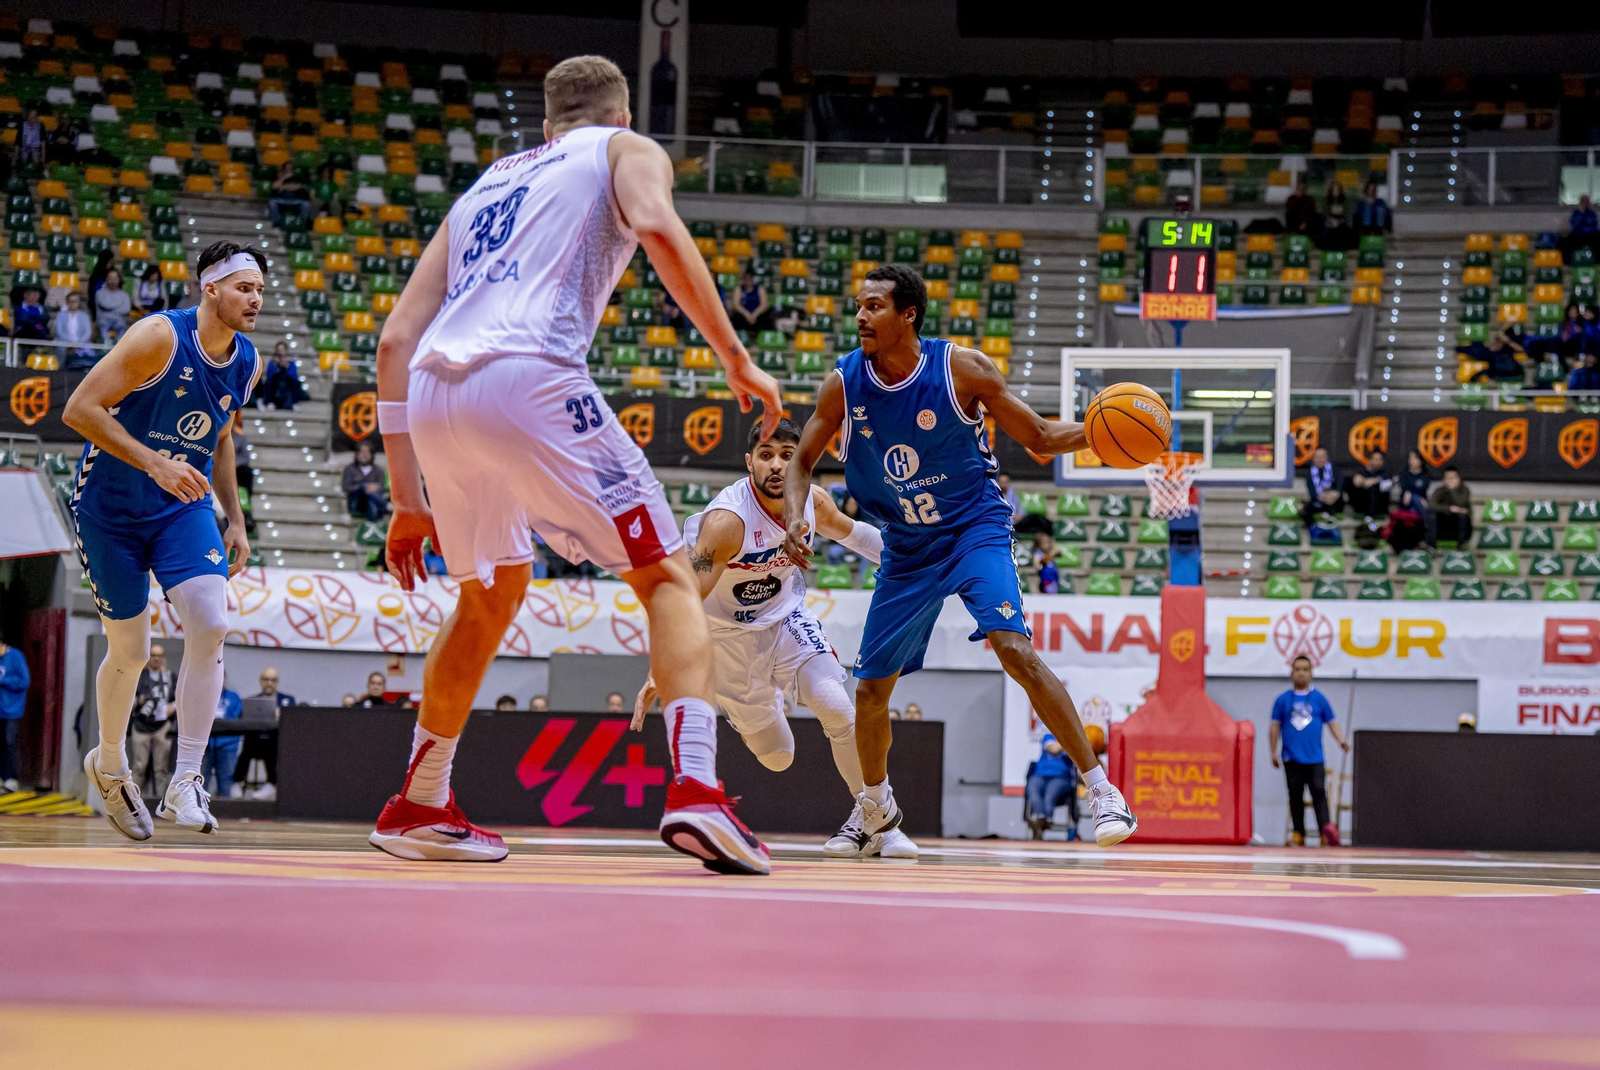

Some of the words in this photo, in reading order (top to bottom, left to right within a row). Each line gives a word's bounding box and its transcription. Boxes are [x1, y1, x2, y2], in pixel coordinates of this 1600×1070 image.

[651, 0, 679, 28] C
[462, 185, 530, 268] 33
[1147, 304, 1209, 318] GANAR
[565, 393, 604, 434] 33
[148, 431, 180, 444] GRUPO
[905, 473, 948, 491] HEREDA
[898, 492, 943, 524] 32
[985, 612, 1210, 655] INA
[1518, 685, 1590, 697] BURGOS
[1518, 703, 1600, 726] FINA
[1134, 764, 1222, 784] FINAL
